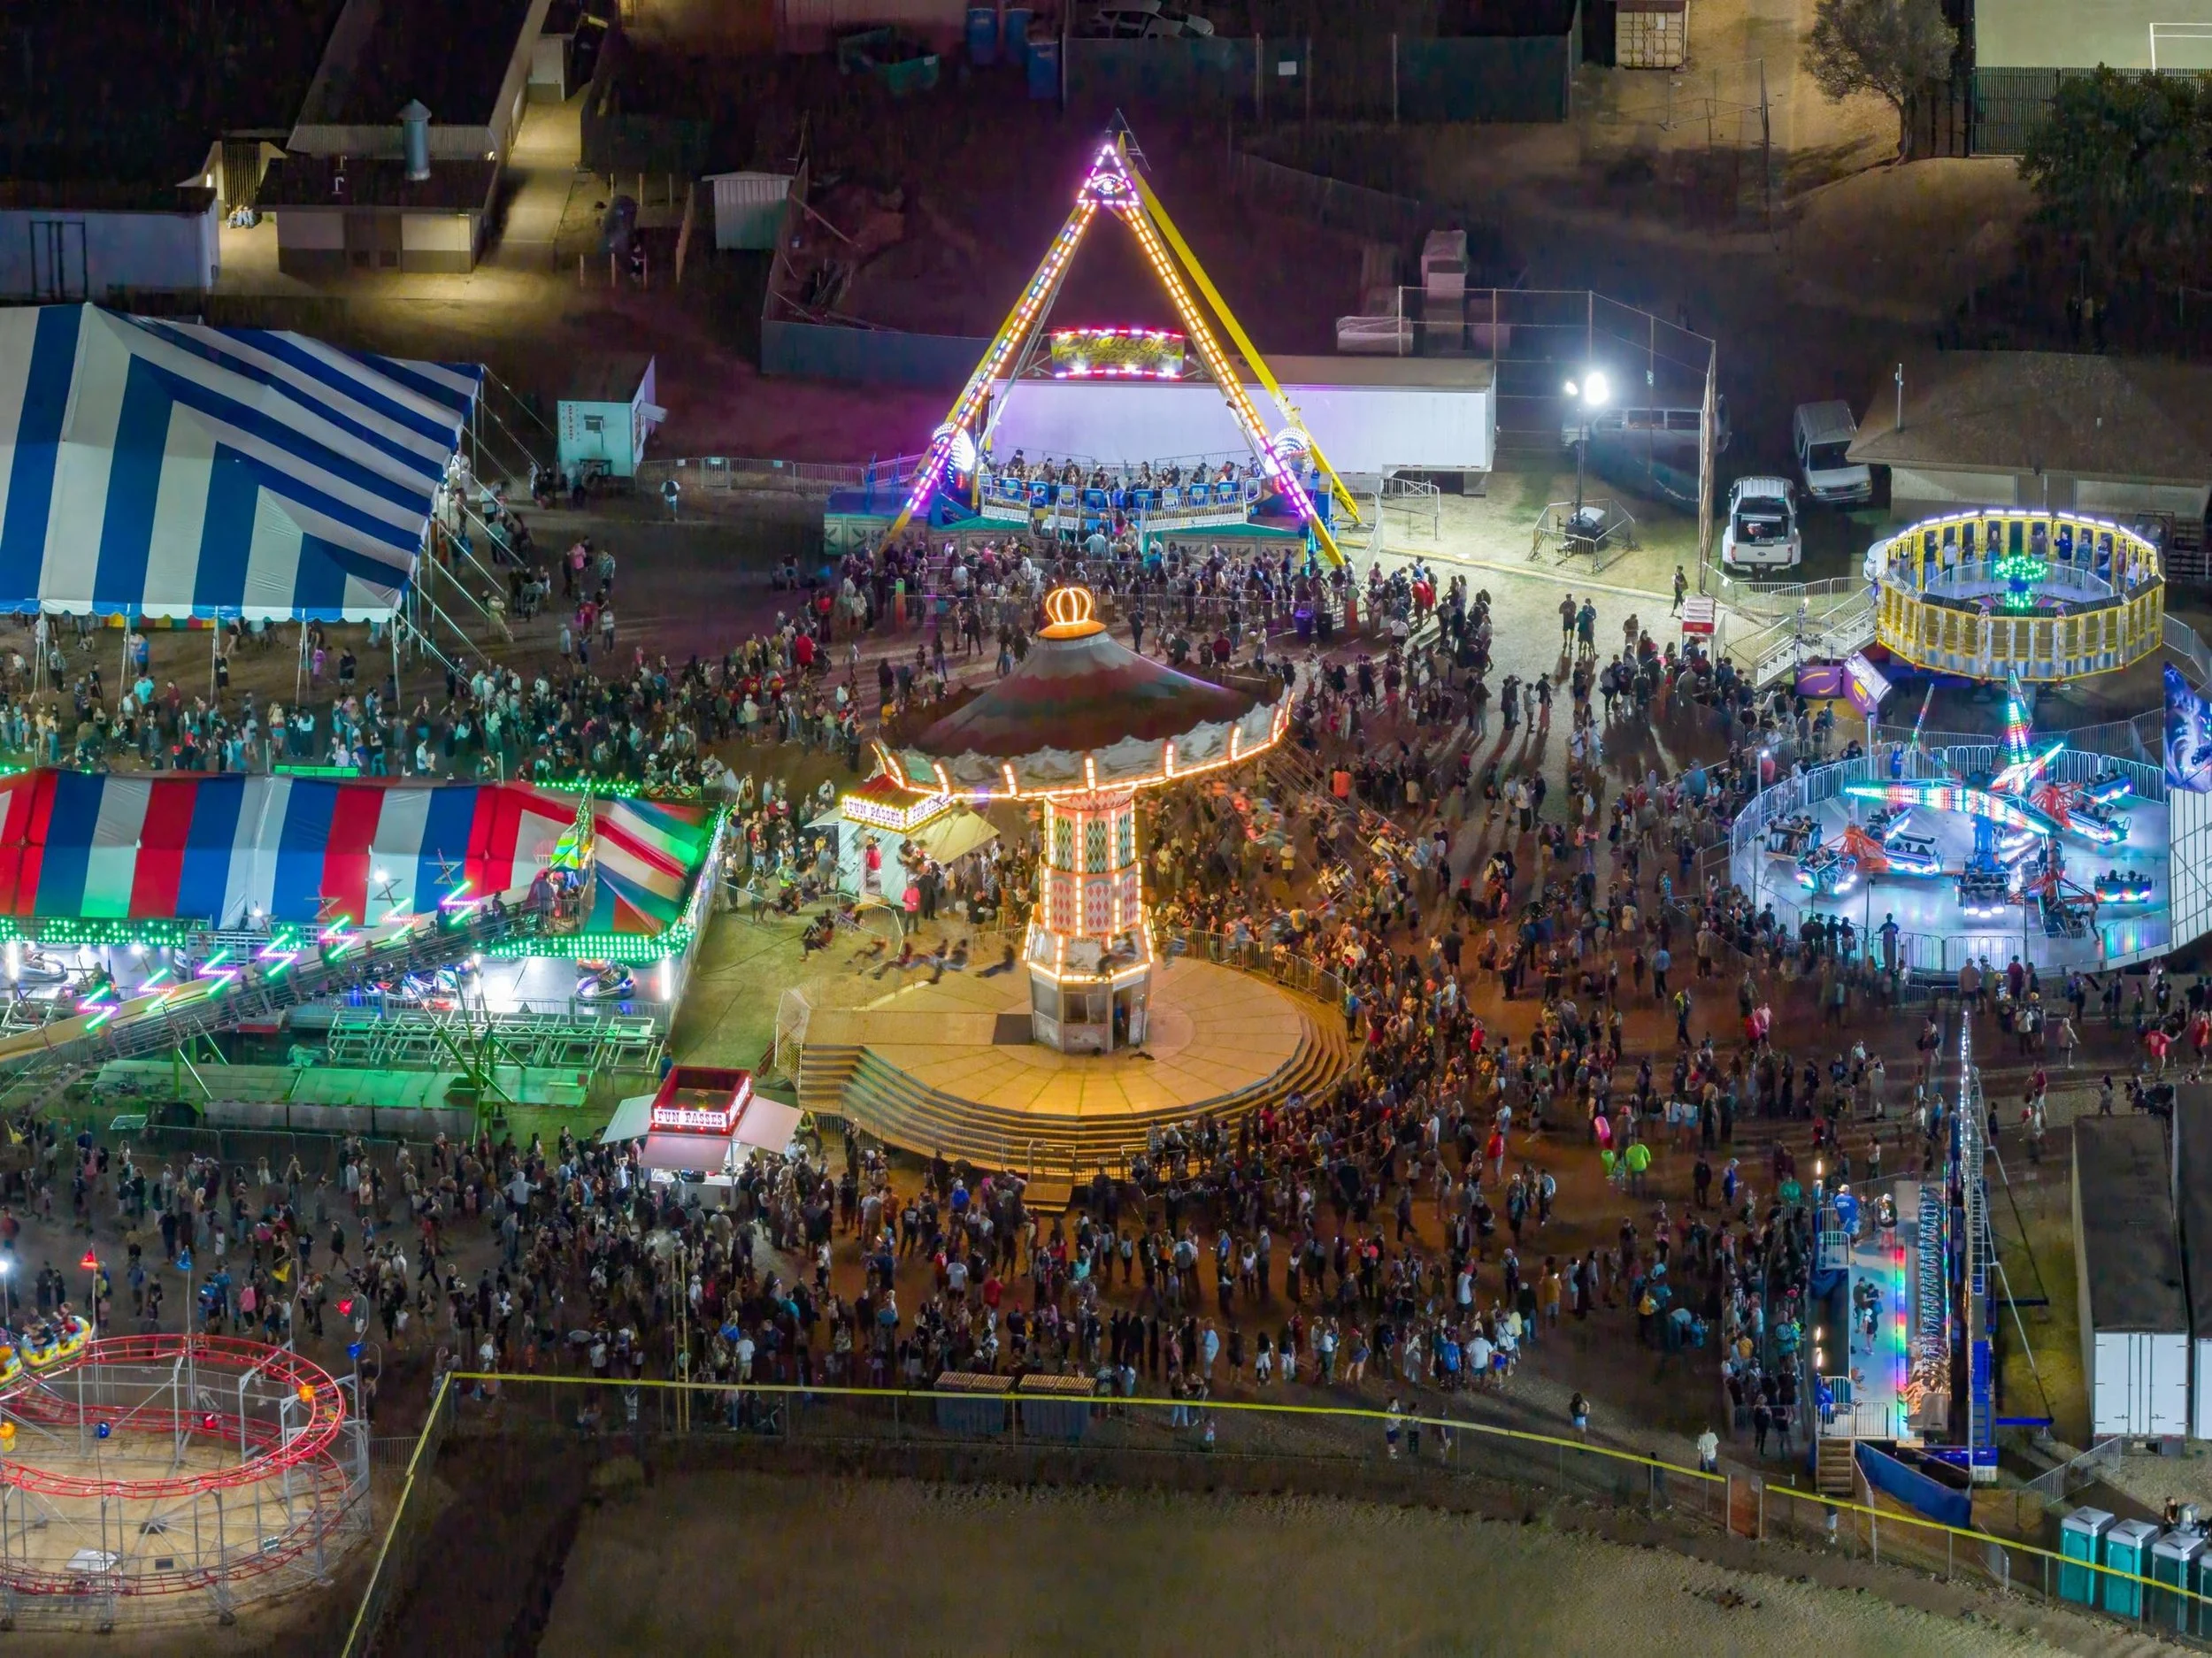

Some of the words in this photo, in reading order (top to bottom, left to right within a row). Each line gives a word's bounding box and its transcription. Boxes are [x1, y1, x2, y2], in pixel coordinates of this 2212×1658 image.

[849, 801, 866, 815] FUN
[871, 806, 901, 824] PASSES
[657, 1110, 680, 1123] FUN
[685, 1112, 723, 1125] PASSES
